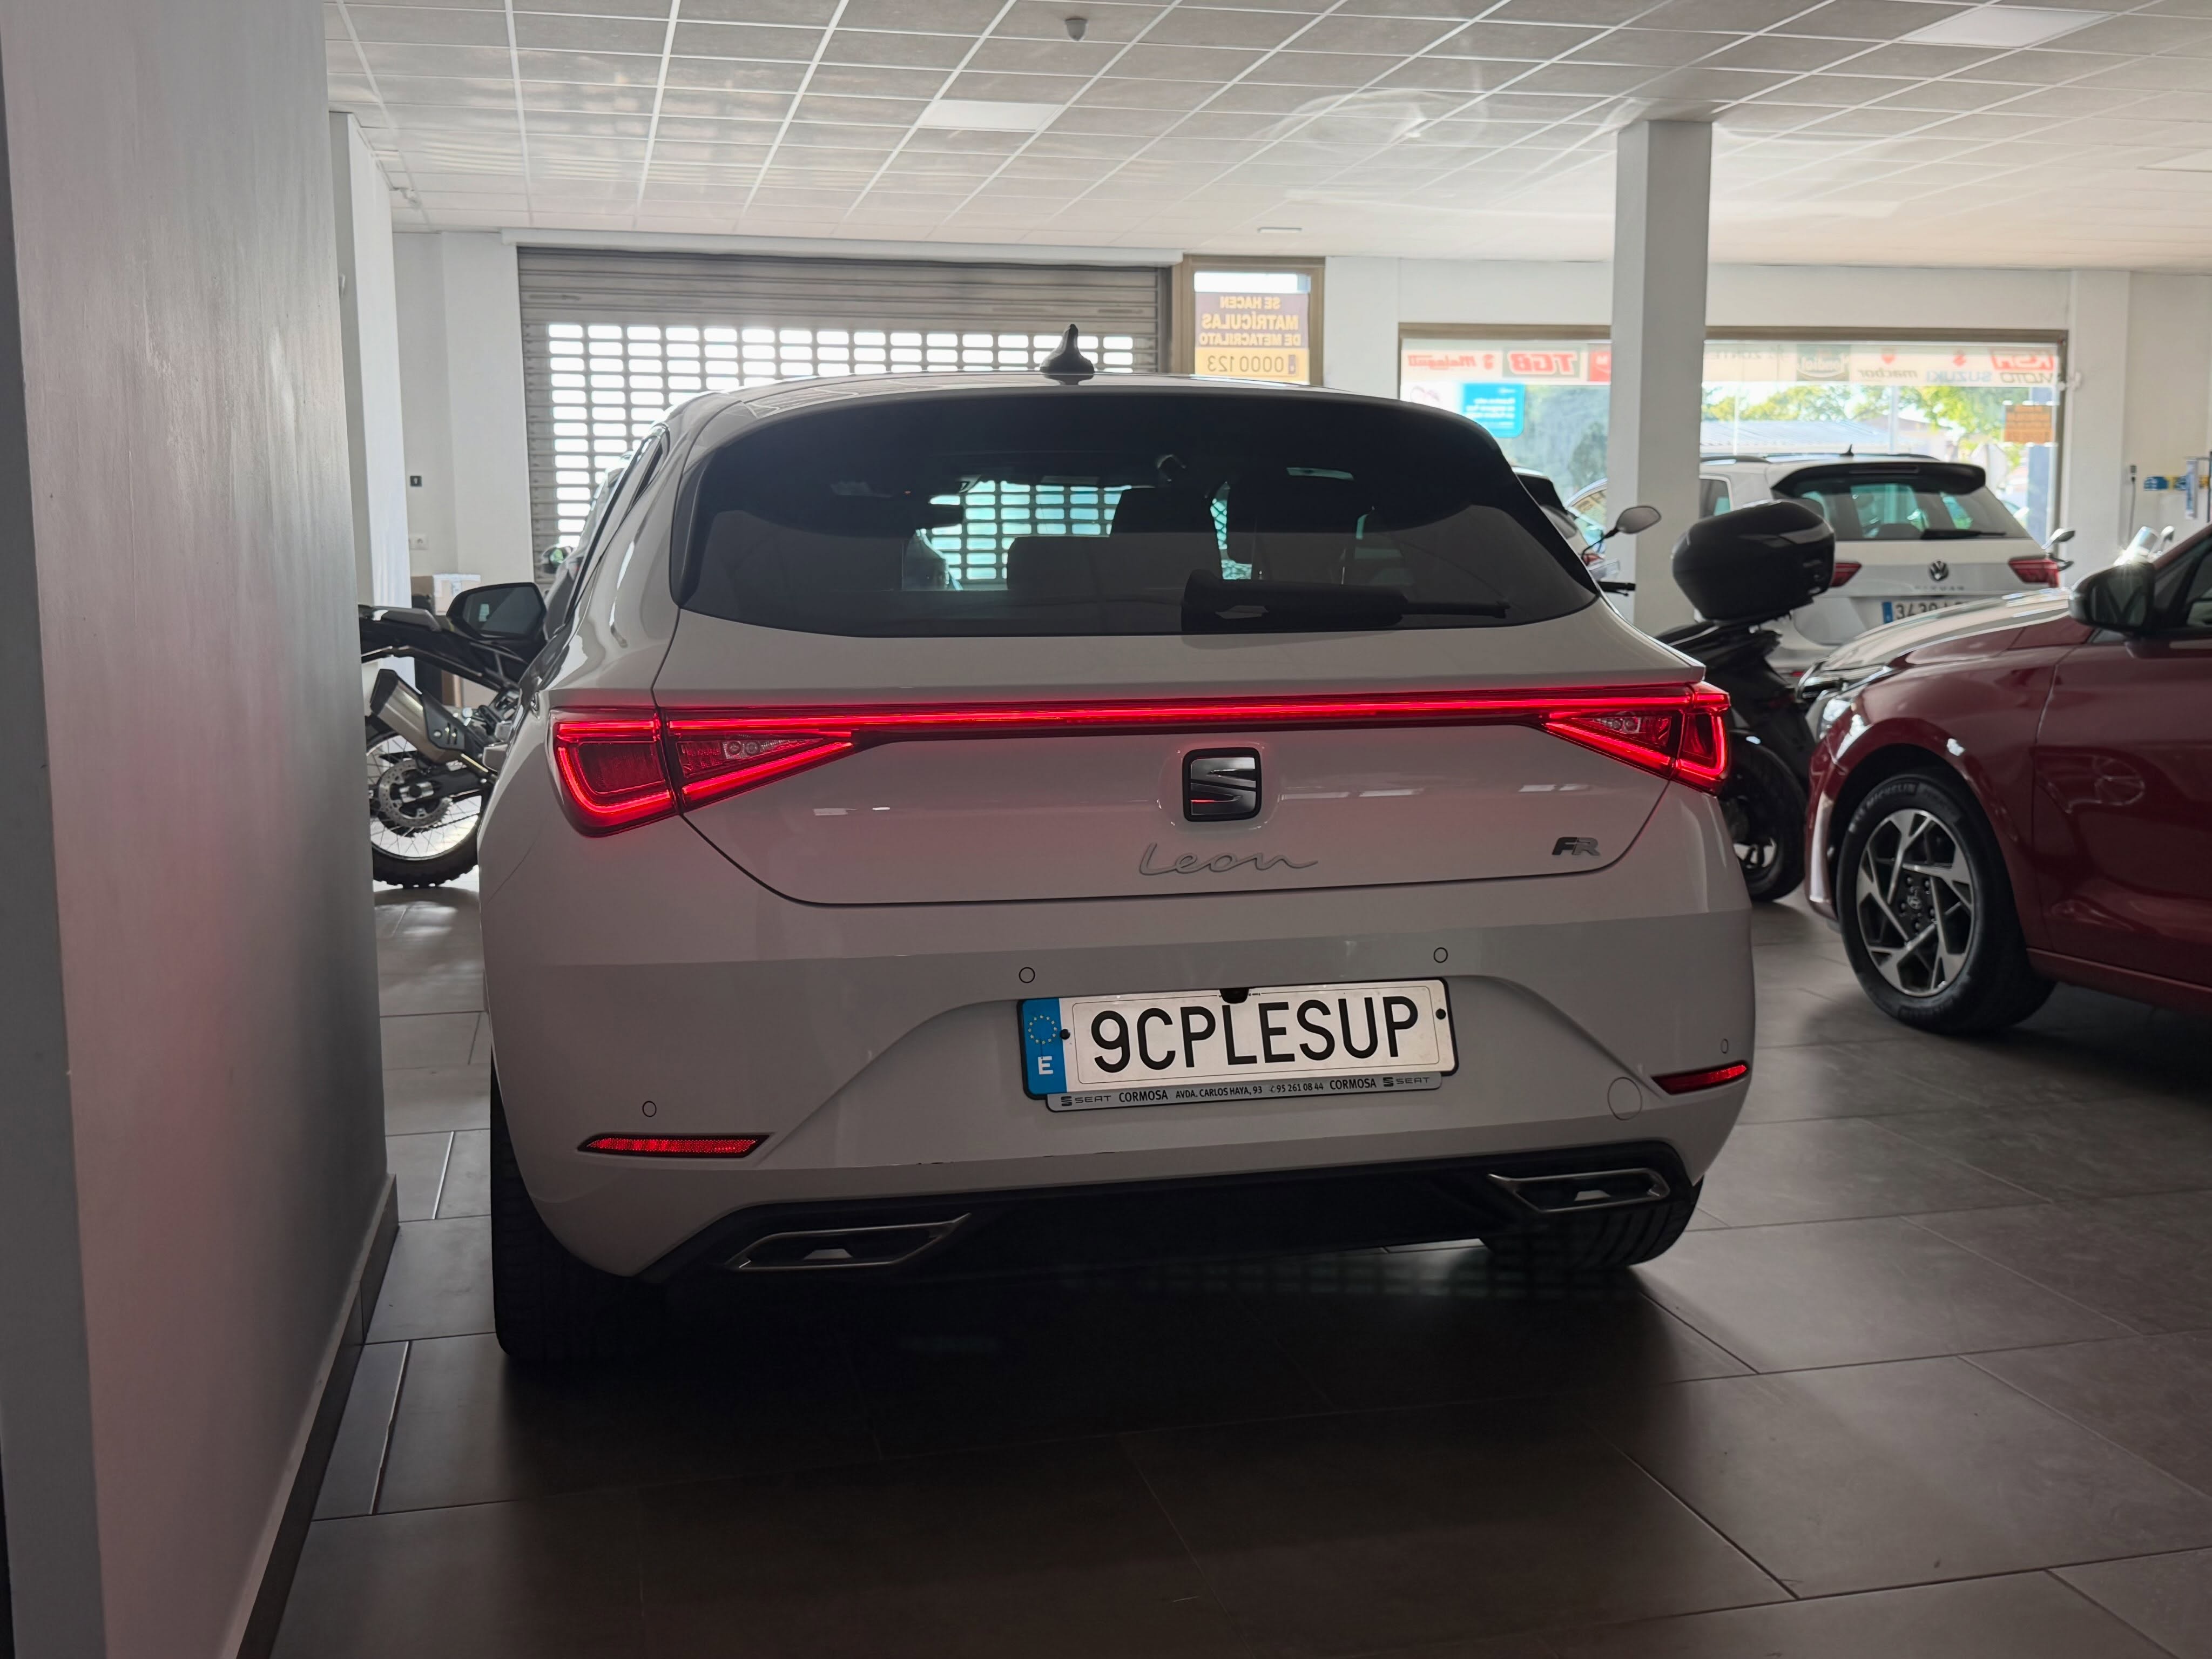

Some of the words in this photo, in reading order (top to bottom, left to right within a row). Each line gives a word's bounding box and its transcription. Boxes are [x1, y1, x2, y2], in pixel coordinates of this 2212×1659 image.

[1139, 842, 1318, 876] Leon
[1552, 837, 1601, 856] FR
[1090, 995, 1419, 1074] 9CPLESUP
[1038, 1056, 1053, 1075] E
[1075, 1095, 1111, 1103] SEAT
[1118, 1089, 1169, 1102] CORMOSA
[1176, 1089, 1198, 1098] AVDA.
[1199, 1087, 1229, 1097] CARLOS
[1230, 1086, 1251, 1095] HAYA,
[1252, 1086, 1263, 1094] 93
[1276, 1084, 1286, 1093] 95
[1287, 1083, 1301, 1091] 261
[1303, 1083, 1313, 1091] 08
[1314, 1082, 1324, 1090] 44
[1330, 1078, 1377, 1090] CORMOSA
